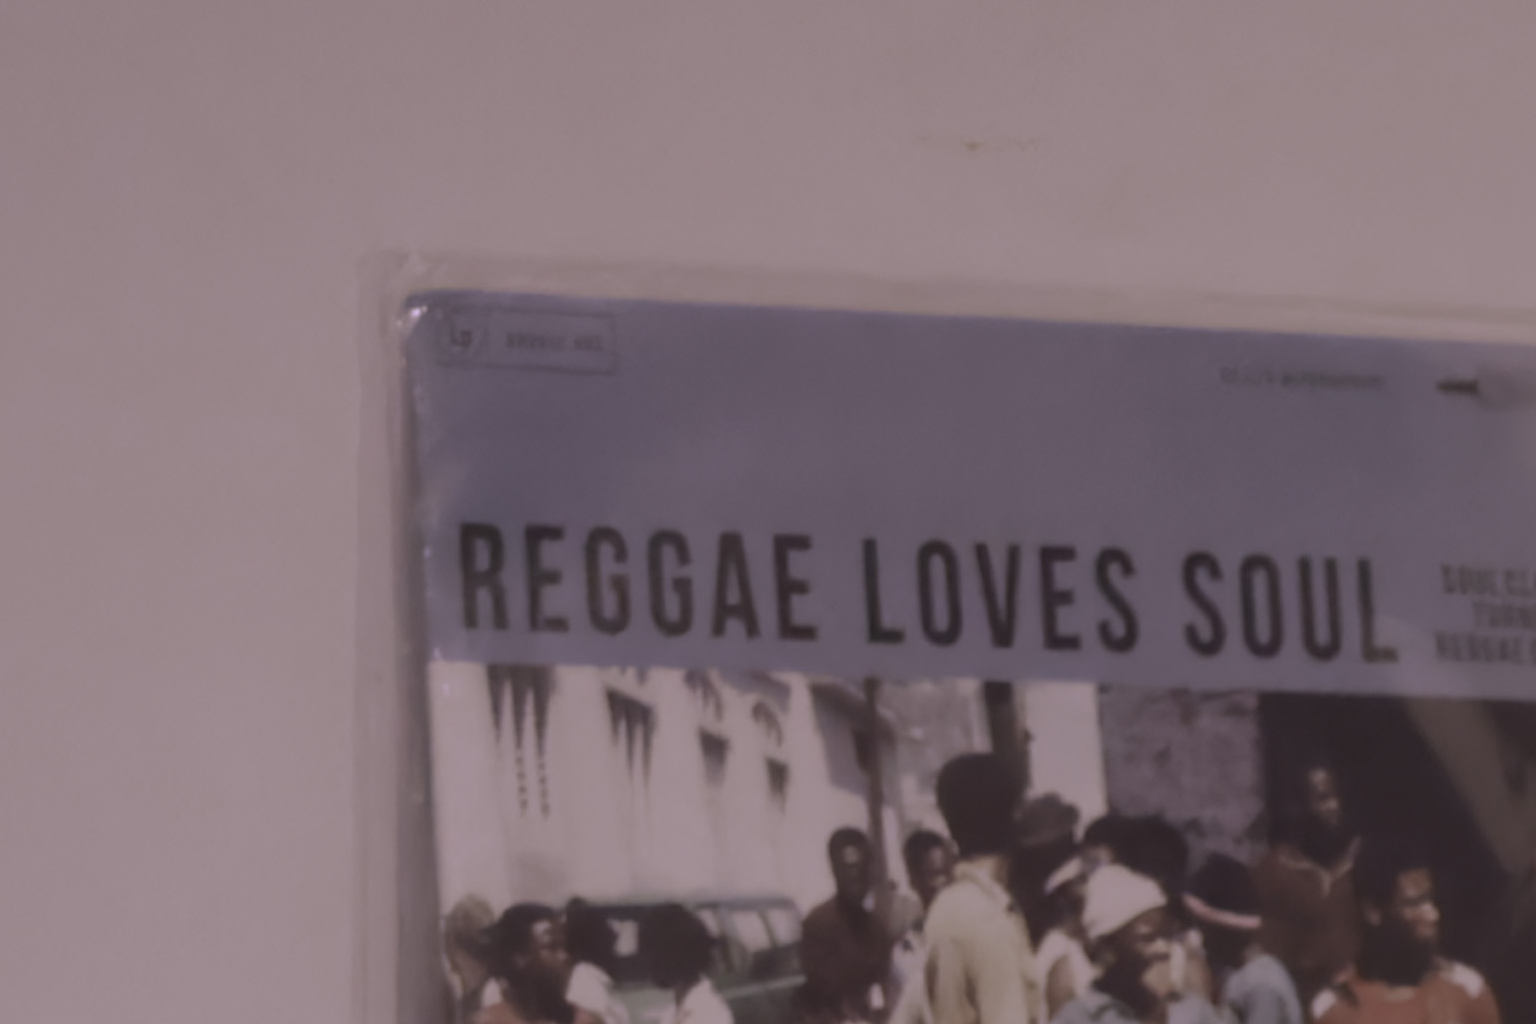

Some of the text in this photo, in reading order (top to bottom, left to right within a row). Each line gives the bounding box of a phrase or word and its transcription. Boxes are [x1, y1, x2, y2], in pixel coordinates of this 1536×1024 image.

[457, 521, 1399, 664] REGGAE LOVES SOUL
